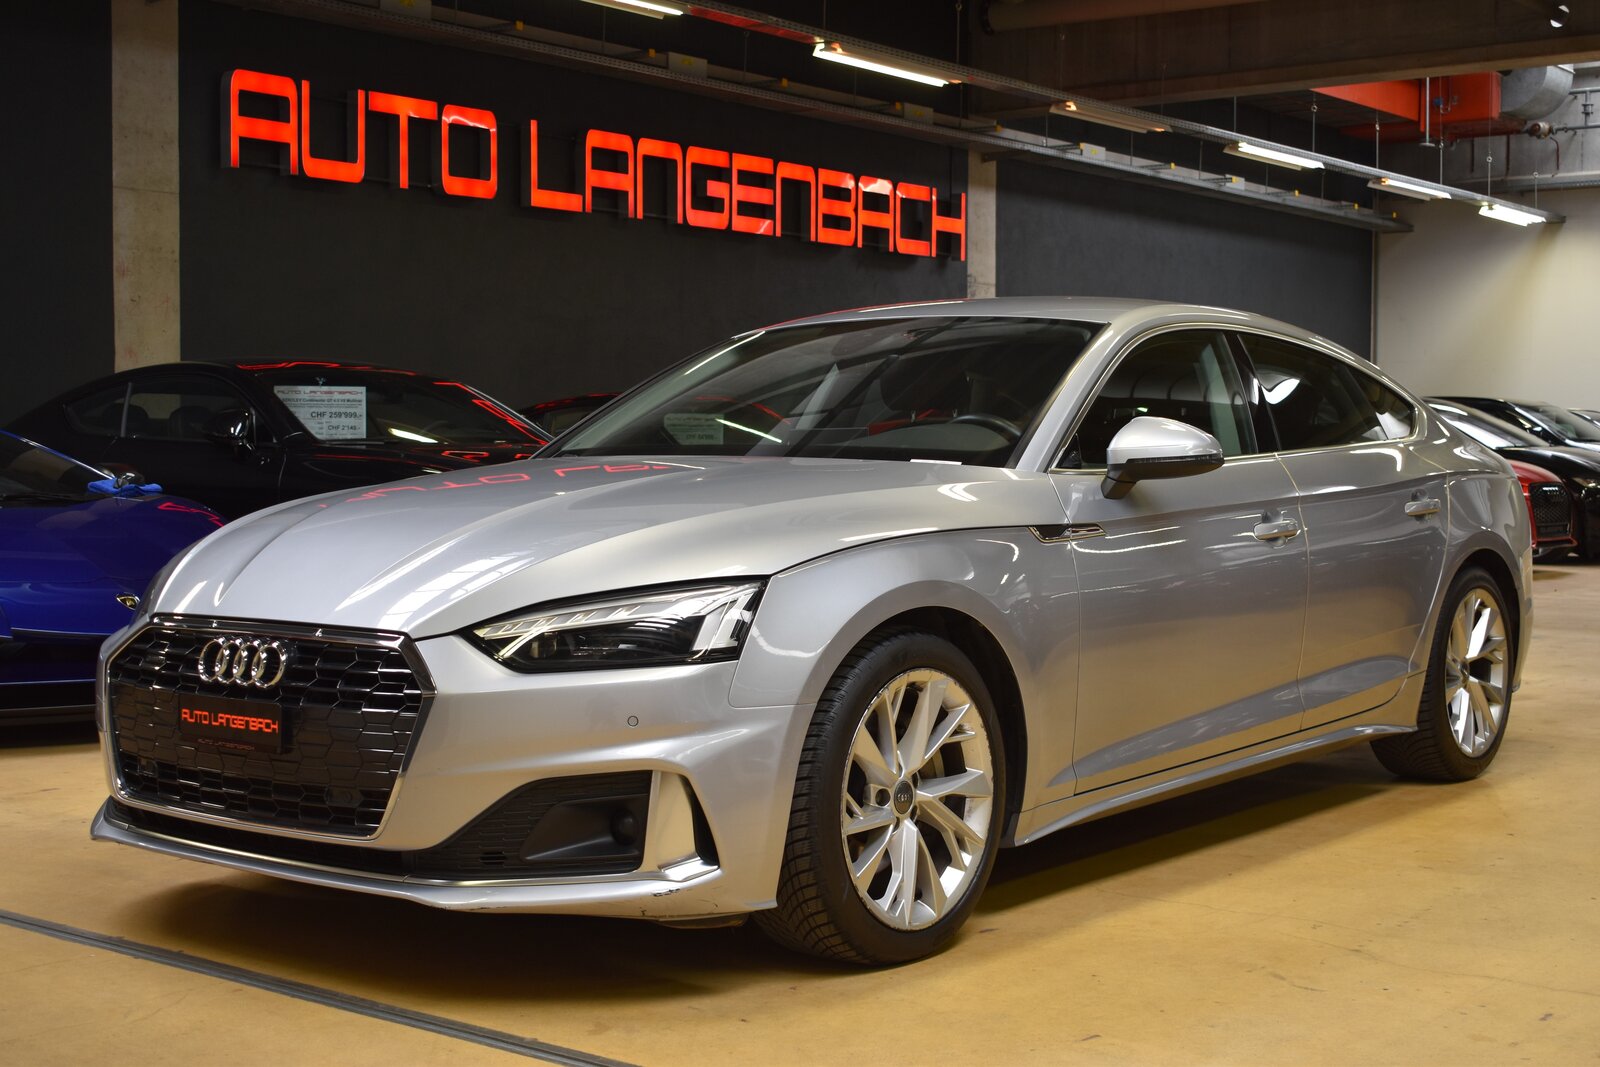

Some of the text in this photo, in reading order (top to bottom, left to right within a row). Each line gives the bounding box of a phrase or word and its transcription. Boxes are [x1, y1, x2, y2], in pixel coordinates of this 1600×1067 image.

[230, 69, 966, 262] AUTO LANGENBACH
[310, 411, 328, 419] CHF
[181, 708, 279, 735] AUTO LANGENBACH
